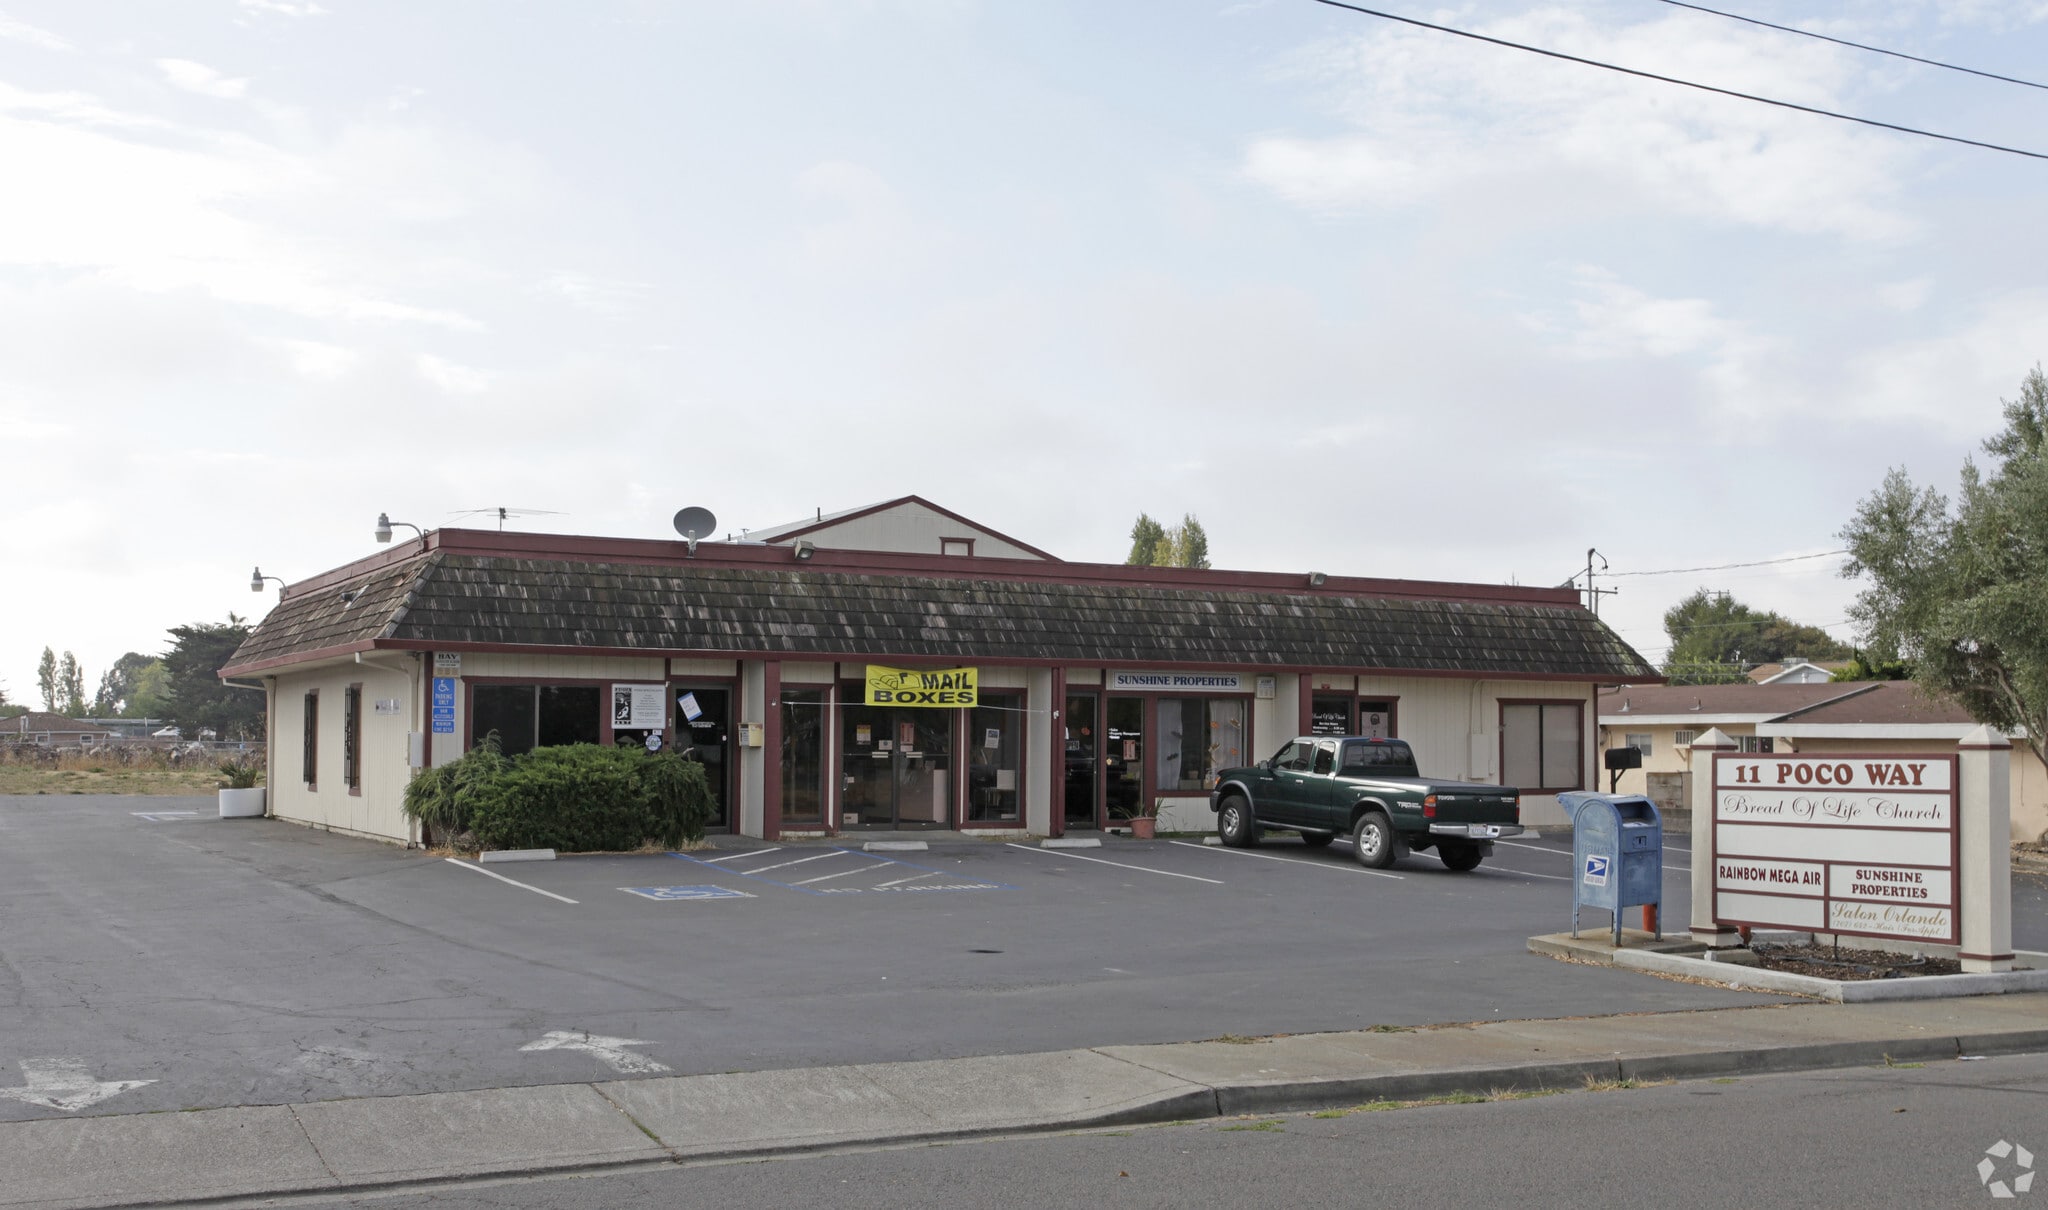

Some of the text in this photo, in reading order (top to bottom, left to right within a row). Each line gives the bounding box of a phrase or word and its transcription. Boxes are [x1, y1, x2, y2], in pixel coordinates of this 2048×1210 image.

[921, 672, 973, 690] MAIL
[1117, 675, 1237, 687] SUNSHINE PROPERTIES
[874, 690, 974, 704] BOXES
[1735, 763, 1927, 786] 11 POCO WAY
[1723, 794, 1942, 823] Bread Of Life Church
[1719, 865, 1821, 886] RAINBOW MEGA AIR
[1855, 869, 1923, 883] SUNSHINE
[1851, 884, 1928, 899] PROPERTIES
[1831, 902, 1947, 926] Salon Orlando
